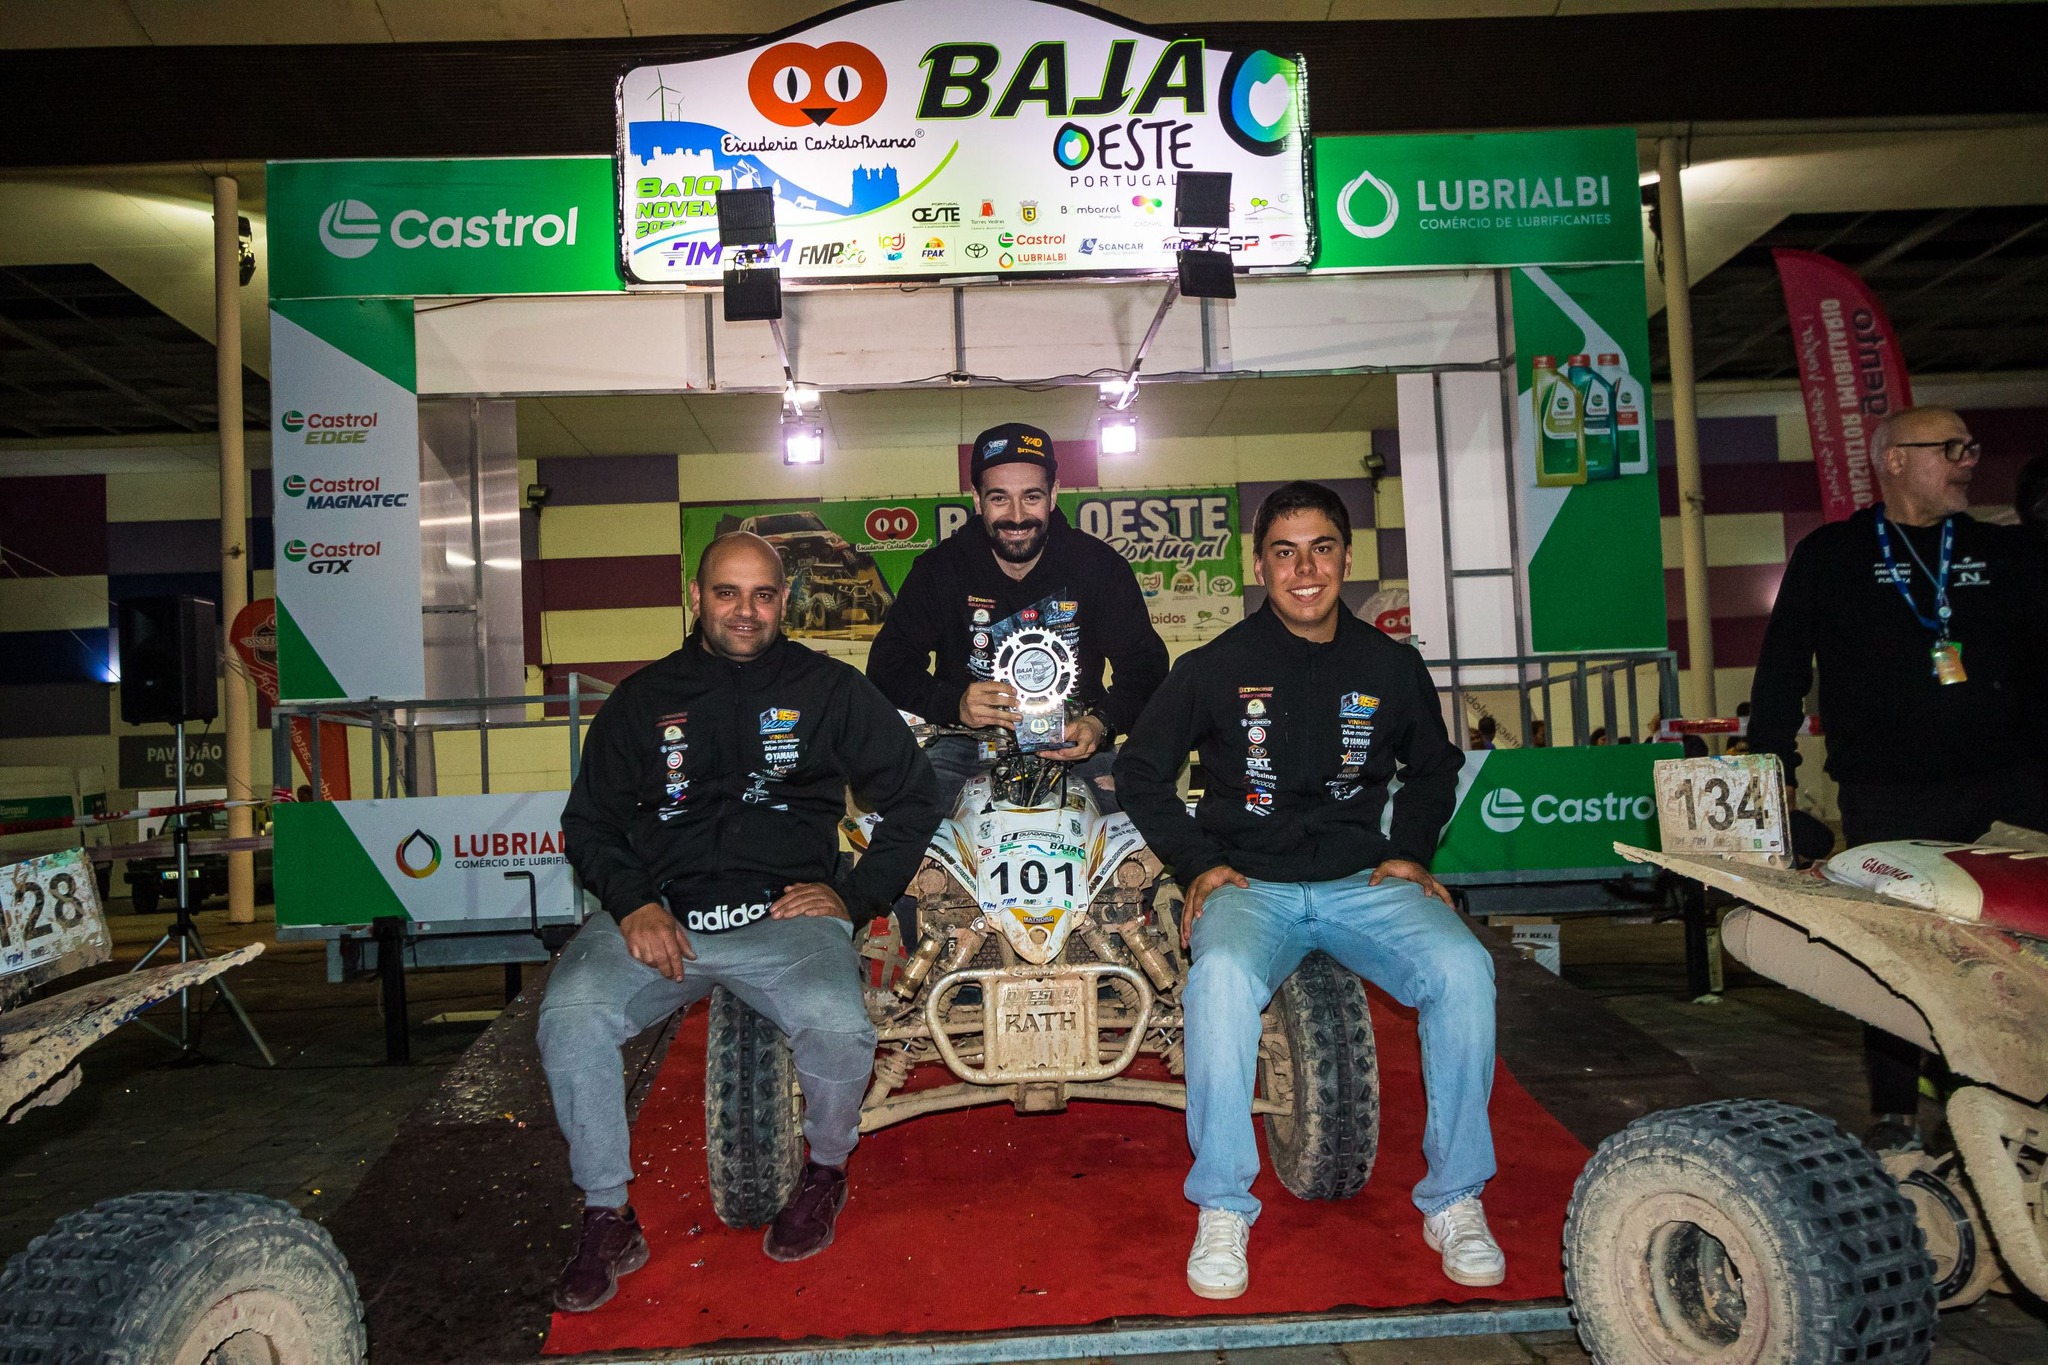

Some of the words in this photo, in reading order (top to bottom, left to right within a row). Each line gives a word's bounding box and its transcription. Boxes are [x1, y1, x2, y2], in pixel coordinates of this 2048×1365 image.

[916, 39, 1207, 120] BAJA
[723, 137, 798, 152] Escuderia
[1053, 118, 1193, 171] OESTE
[1070, 175, 1178, 188] PORTUGAL
[1417, 176, 1610, 212] LUBRIALBI
[635, 201, 718, 219] NOVEM
[390, 206, 578, 249] Castrol
[1420, 215, 1491, 230] COMÉRCIO
[1497, 217, 1513, 228] DE
[1518, 214, 1611, 227] LUBRIFICANTES
[1016, 234, 1066, 245] Castrol
[1098, 243, 1144, 251] SCANCAR
[799, 242, 844, 265] FMP
[921, 250, 945, 258] FPAK
[1018, 253, 1067, 263] LUBRIALBI
[307, 412, 377, 428] Castrol
[305, 430, 369, 445] EDGE
[309, 477, 380, 493] Castrol
[306, 493, 408, 509] MAGNATEC
[1080, 498, 1227, 541] OESTE
[310, 541, 381, 557] Castrol
[1110, 535, 1229, 569] Portugal
[308, 559, 353, 575] GTX
[1150, 613, 1186, 624] bidos
[1343, 704, 1376, 714] LUIS
[762, 720, 796, 728] LUIS
[1350, 738, 1370, 746] YAMAHA
[147, 742, 222, 761] PAVLHÃO
[773, 751, 799, 760] YAMAHA
[1530, 792, 1656, 824] Castro
[1675, 775, 1769, 830] 134
[454, 831, 566, 858] LUBRIAL
[1050, 842, 1077, 853] BAJA
[455, 858, 509, 869] COMÉRCIO
[513, 858, 525, 867] DE
[529, 857, 570, 866] LUBRIFIC
[990, 860, 1074, 896] 101
